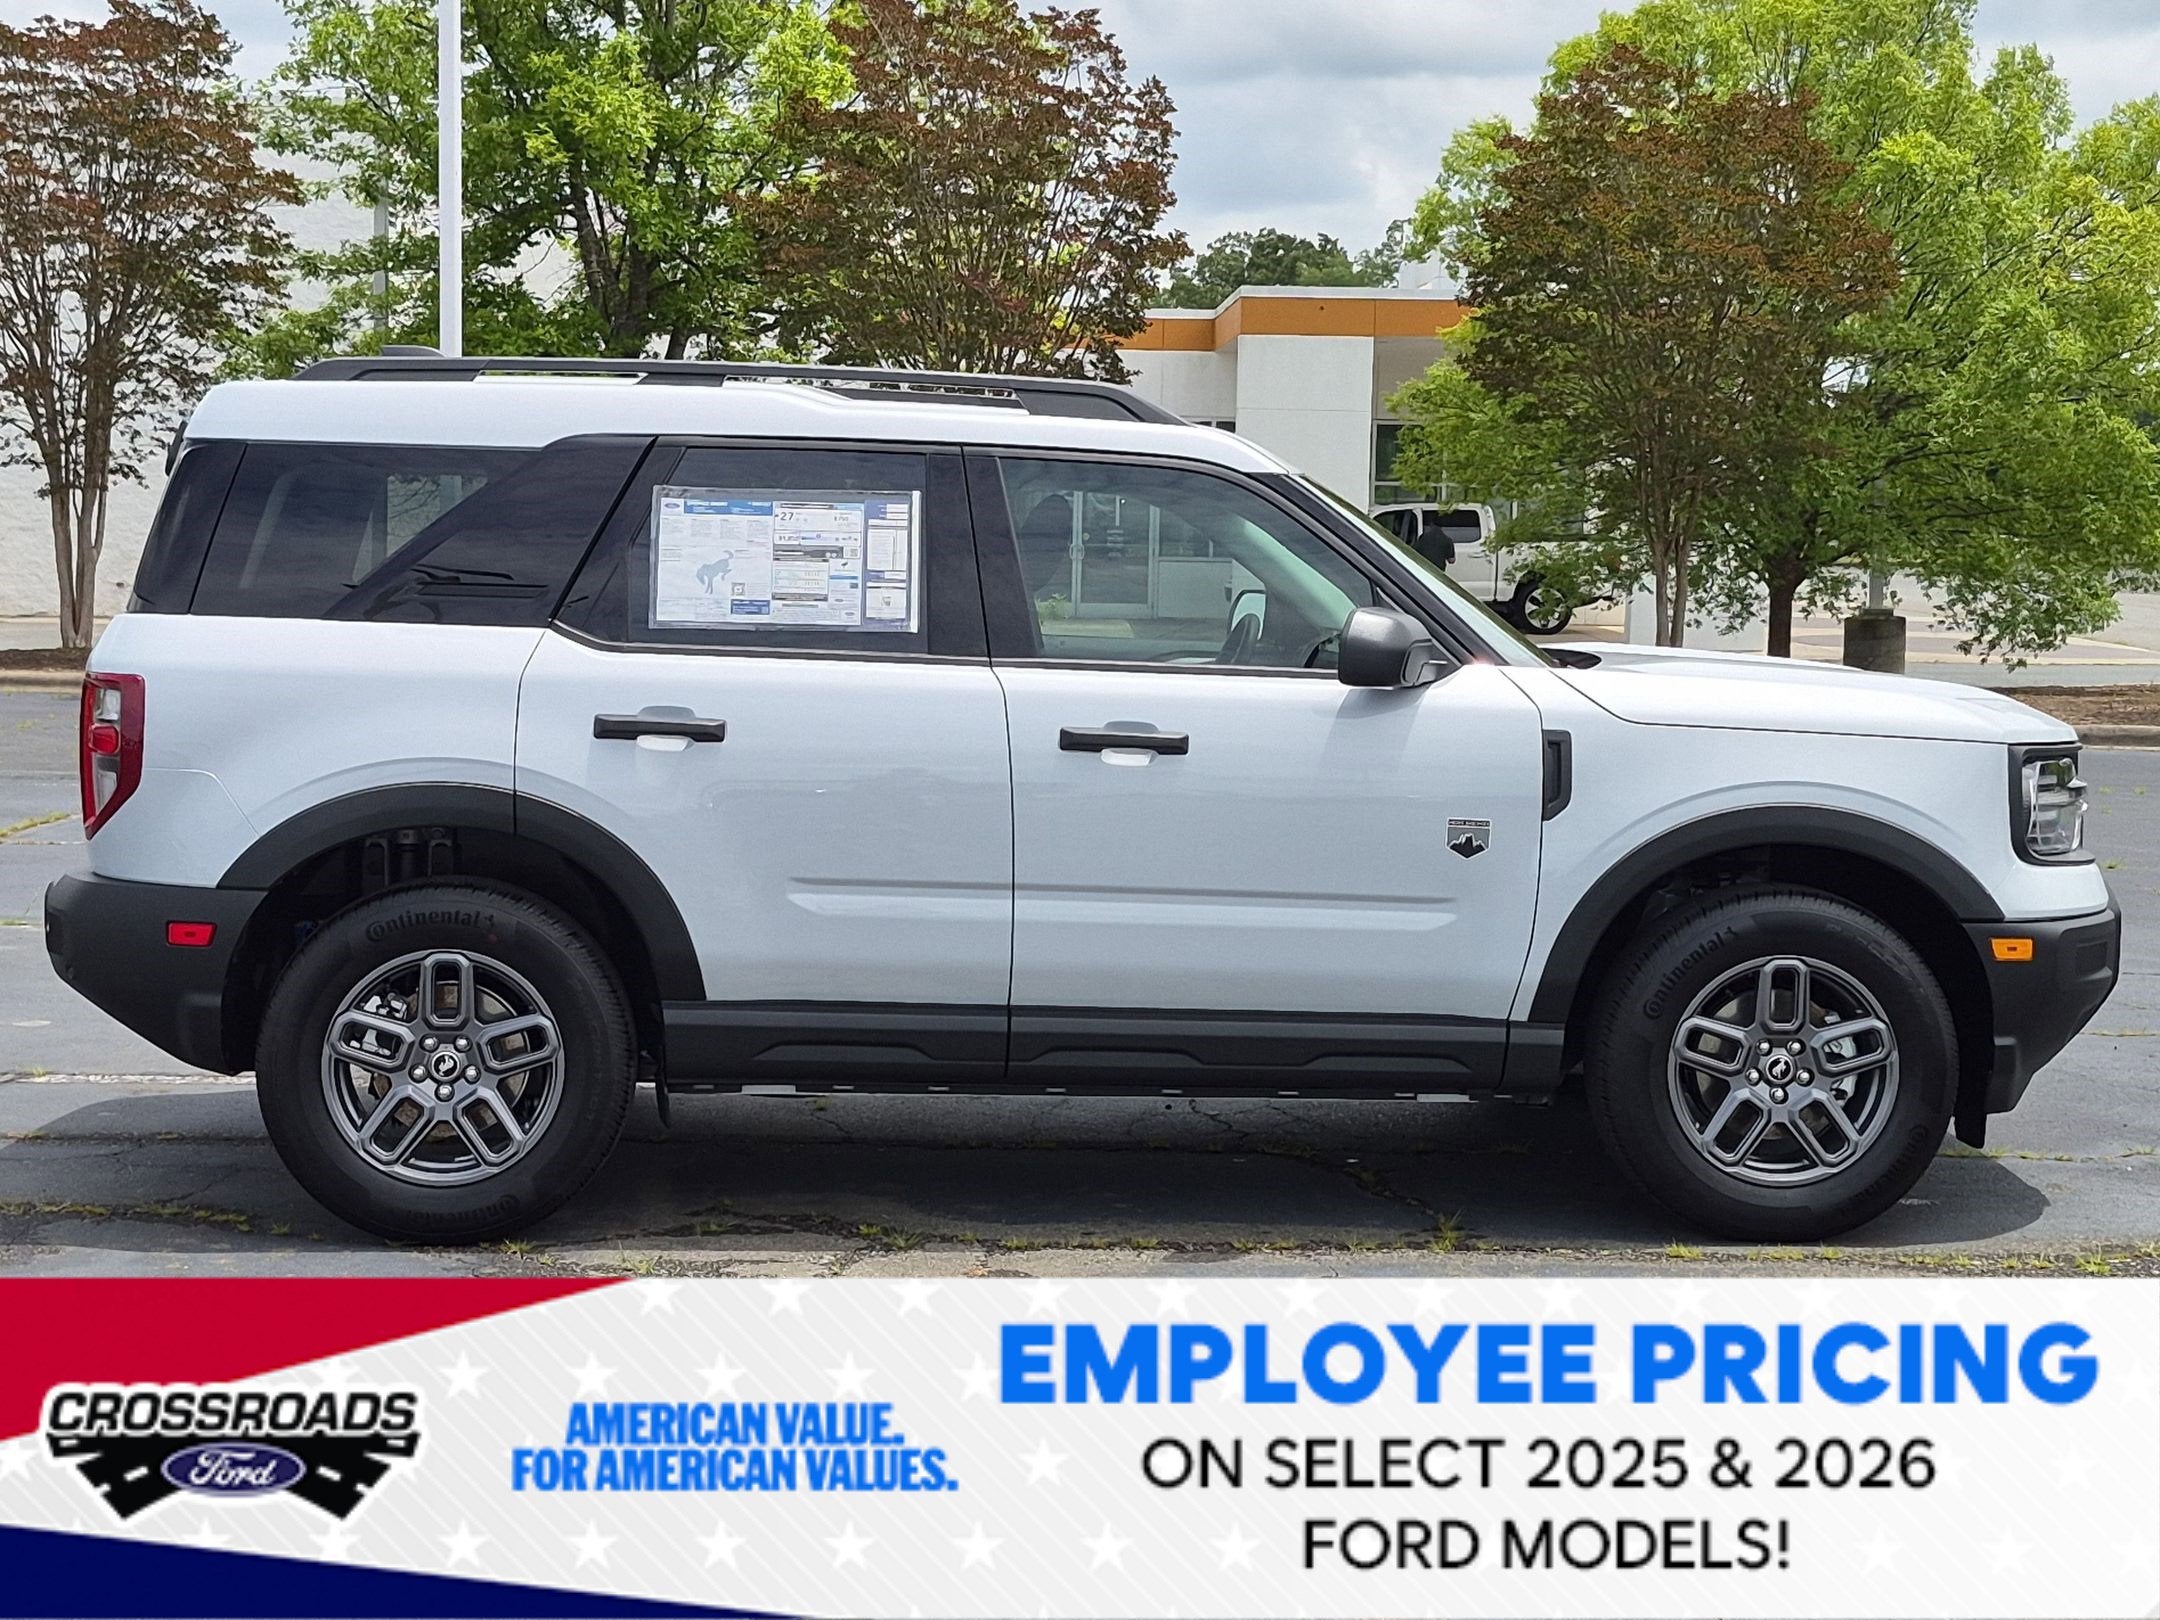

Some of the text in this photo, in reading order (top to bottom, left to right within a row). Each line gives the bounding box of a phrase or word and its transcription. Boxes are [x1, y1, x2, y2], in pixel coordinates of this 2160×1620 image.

[780, 511, 794, 521] 27
[366, 910, 481, 942] Continental
[1643, 931, 1726, 1019] Continental
